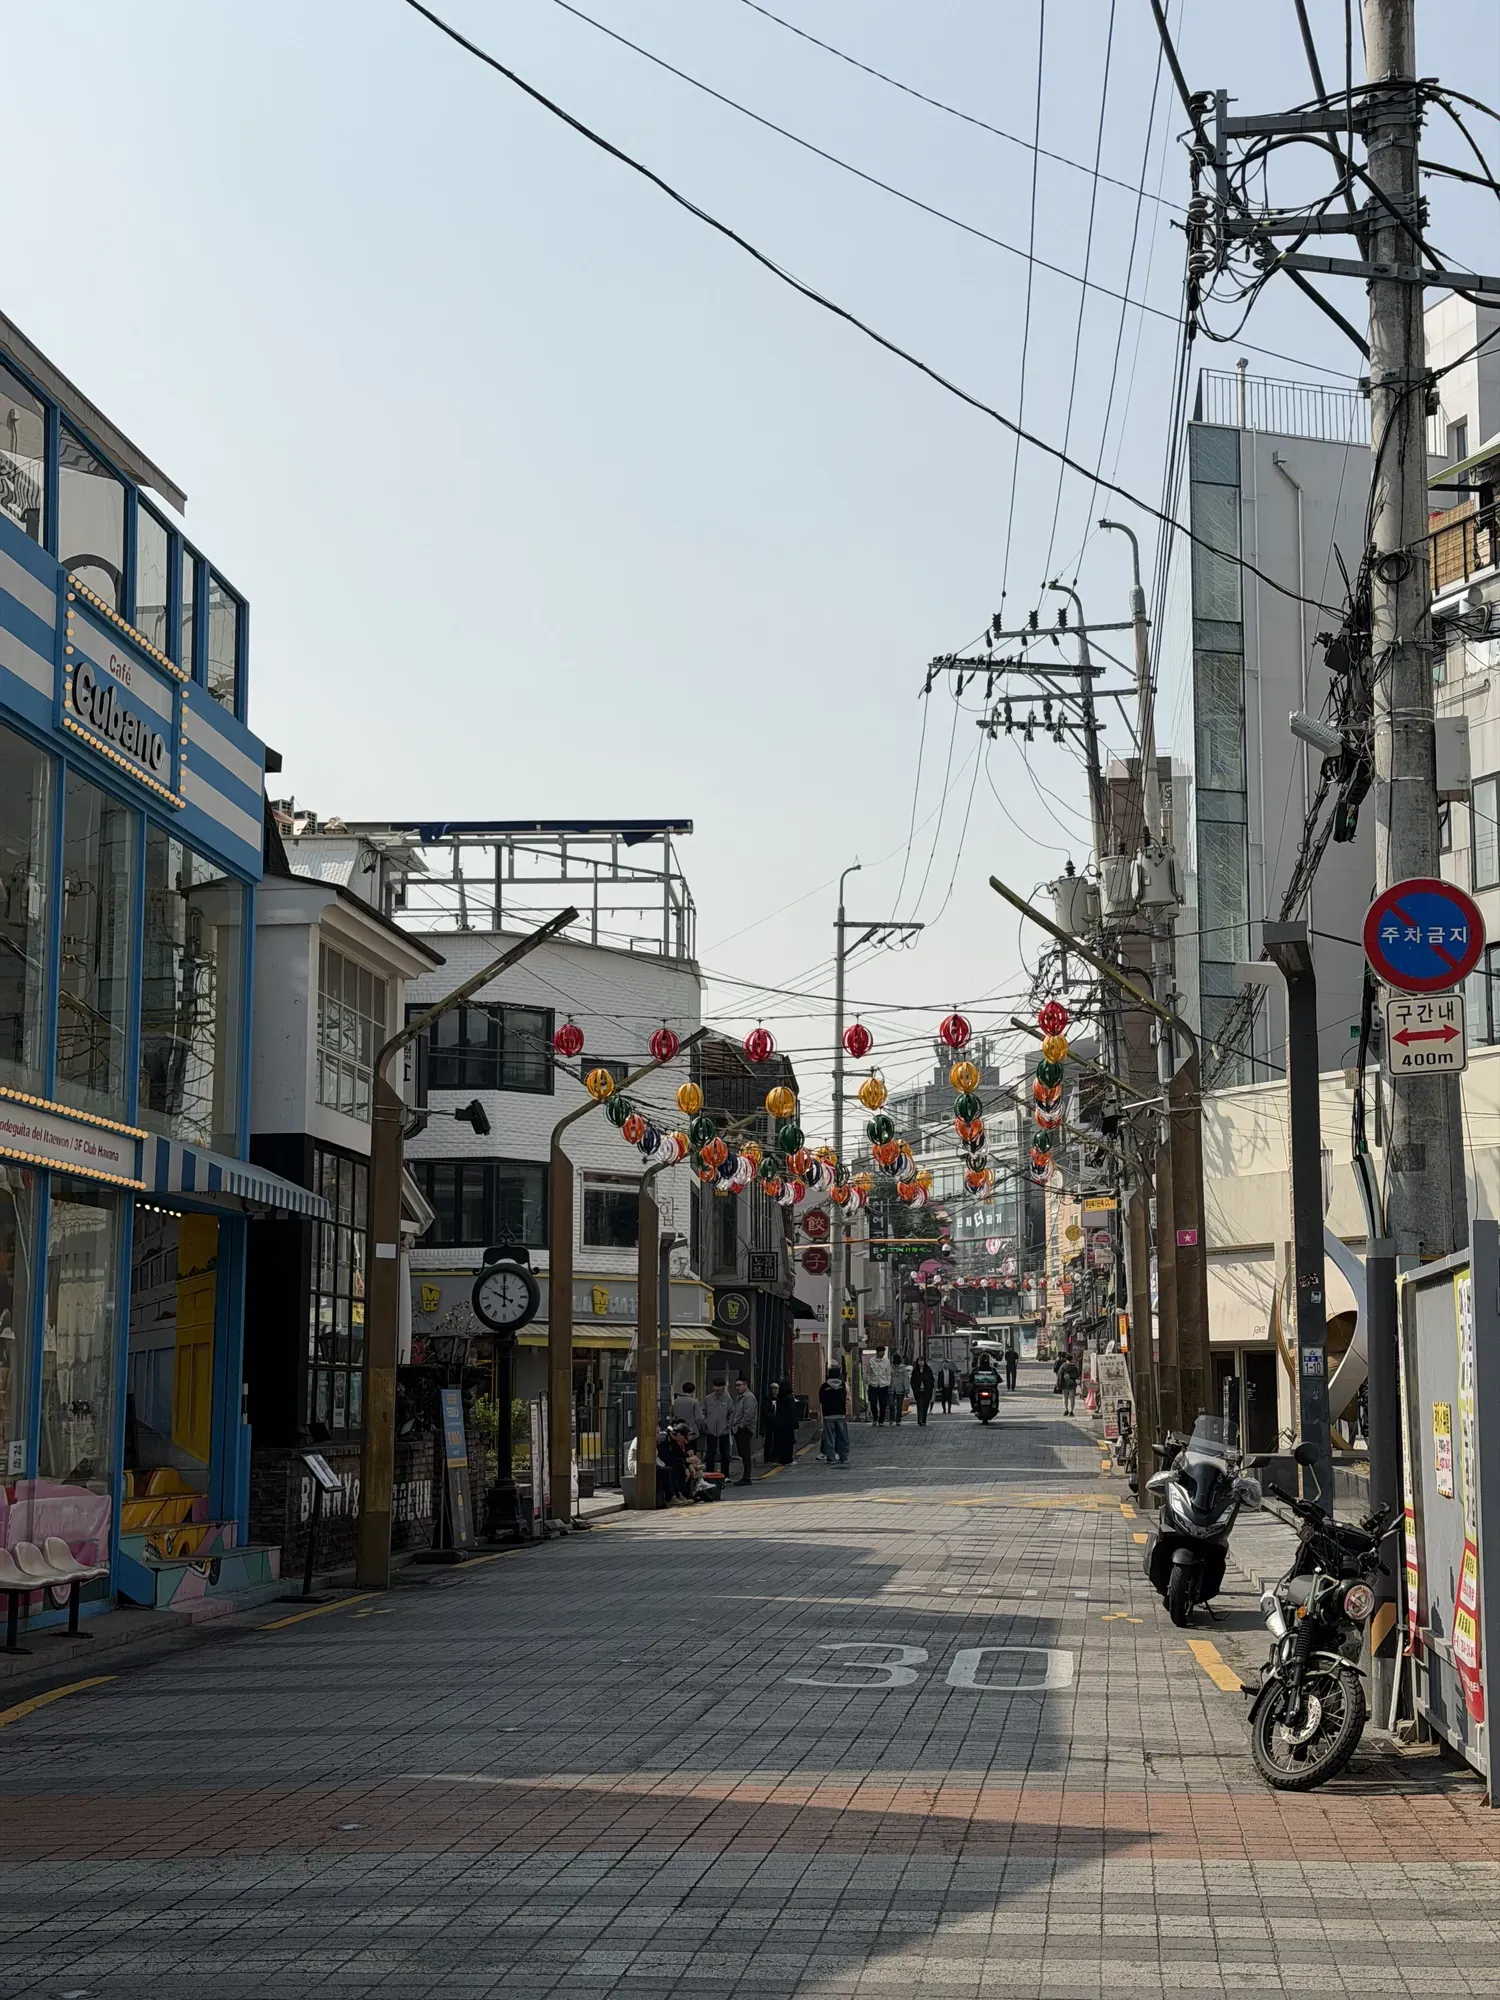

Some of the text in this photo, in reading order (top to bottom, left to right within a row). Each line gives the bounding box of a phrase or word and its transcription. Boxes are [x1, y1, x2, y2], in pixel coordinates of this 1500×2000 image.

[110, 654, 132, 687] Café
[73, 662, 166, 770] Cubano
[1381, 926, 1468, 944] 주차금지
[1396, 1001, 1454, 1025] 구간내
[1402, 1052, 1454, 1067] 400m
[32, 1126, 42, 1141] del
[44, 1129, 70, 1148] Itaewon
[74, 1138, 83, 1151] 3F
[83, 1142, 97, 1156] Club
[98, 1146, 119, 1162] Havana
[1305, 1363, 1322, 1373] 1-10
[784, 1642, 1074, 1690] 30
